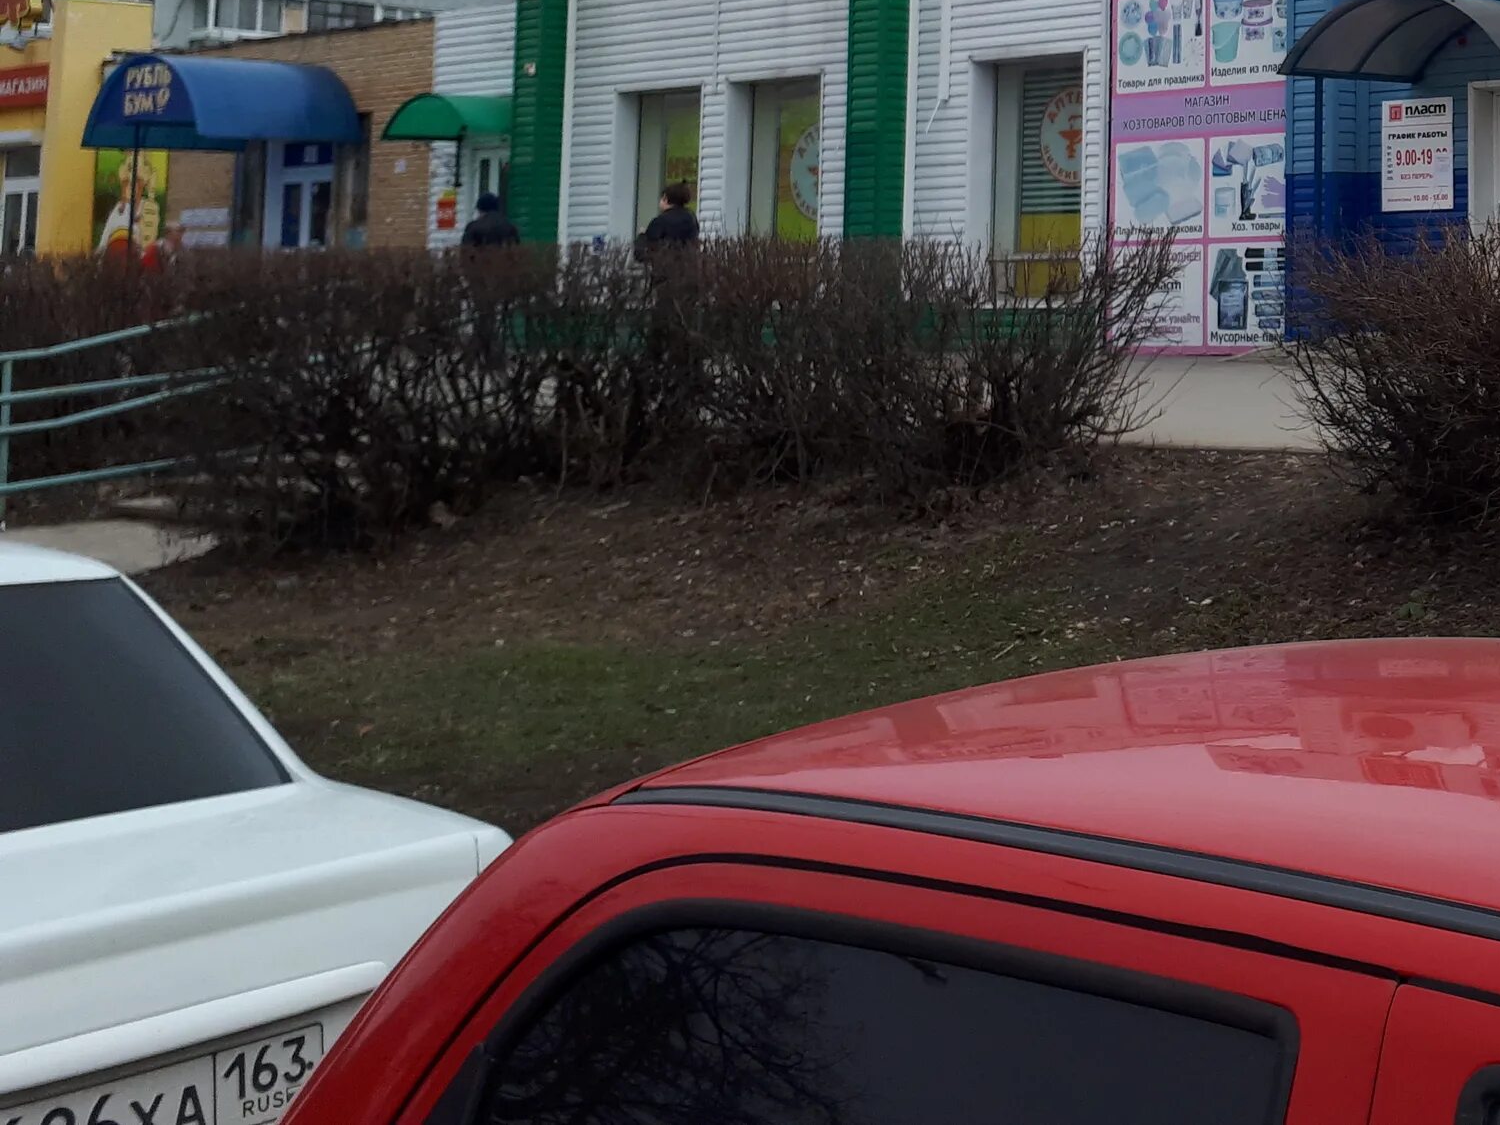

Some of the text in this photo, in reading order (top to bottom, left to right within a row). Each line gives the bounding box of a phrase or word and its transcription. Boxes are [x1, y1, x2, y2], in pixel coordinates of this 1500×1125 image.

[1211, 65, 1247, 77] Изделия
[1249, 64, 1260, 74] из
[1118, 73, 1205, 89] Товары для праздника
[1184, 94, 1230, 108] МАГАЗИН
[1405, 103, 1447, 116] пласт
[1122, 116, 1185, 131] ХОЗТОВАРОВ
[1187, 114, 1203, 127] ПО
[1205, 110, 1257, 126] ОПТОВЫМ
[1388, 130, 1448, 140] ГРАФИК РАБОТЫ
[1231, 221, 1282, 233] Хоз. товары
[1210, 331, 1260, 344] Мусорные
[223, 1035, 308, 1101] 163
[242, 1093, 284, 1118] RUS
